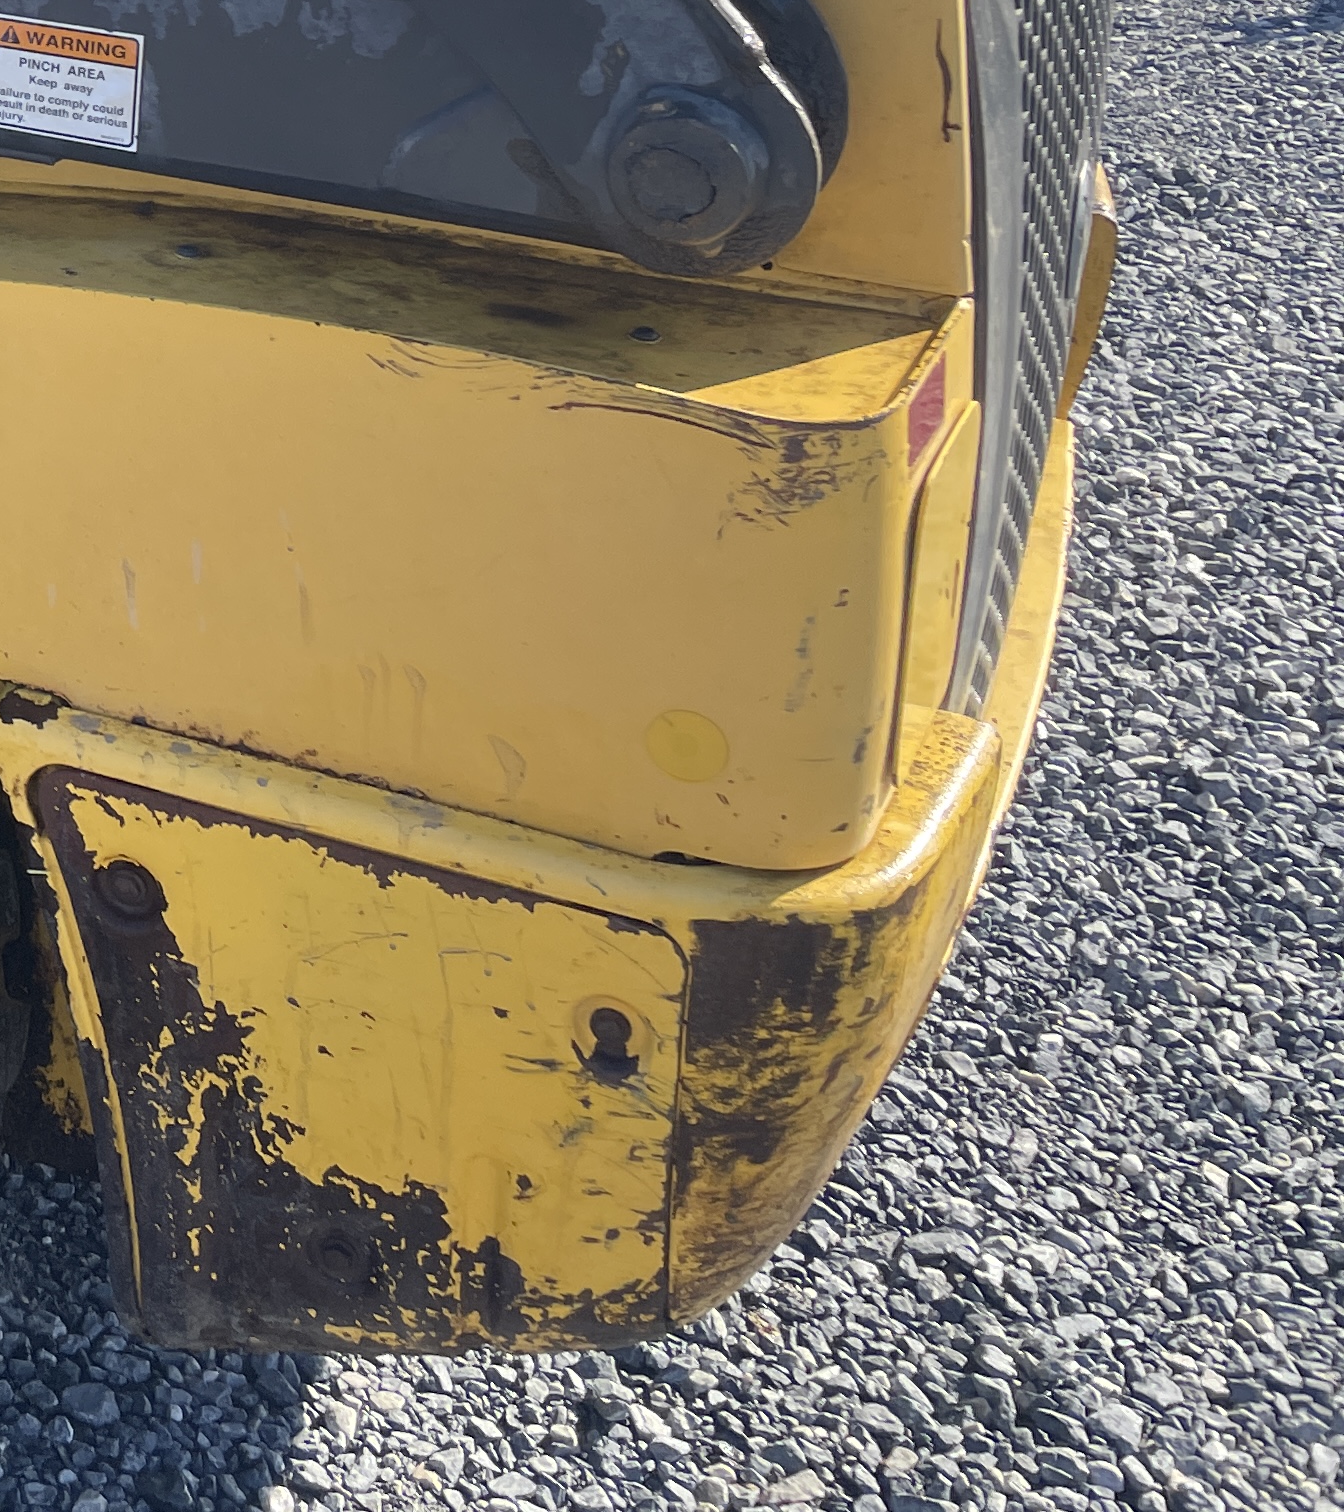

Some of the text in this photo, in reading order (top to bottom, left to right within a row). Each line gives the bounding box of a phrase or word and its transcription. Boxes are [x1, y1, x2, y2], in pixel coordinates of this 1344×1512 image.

[26, 30, 127, 59] WARNING
[18, 56, 106, 81] PINCH AREA
[28, 74, 95, 96] Keep away
[26, 102, 36, 113] in
[38, 104, 70, 119] death
[72, 110, 84, 120] or
[86, 112, 128, 129] serious
[34, 92, 45, 103] to
[47, 95, 90, 113] comply
[92, 103, 125, 116] could
